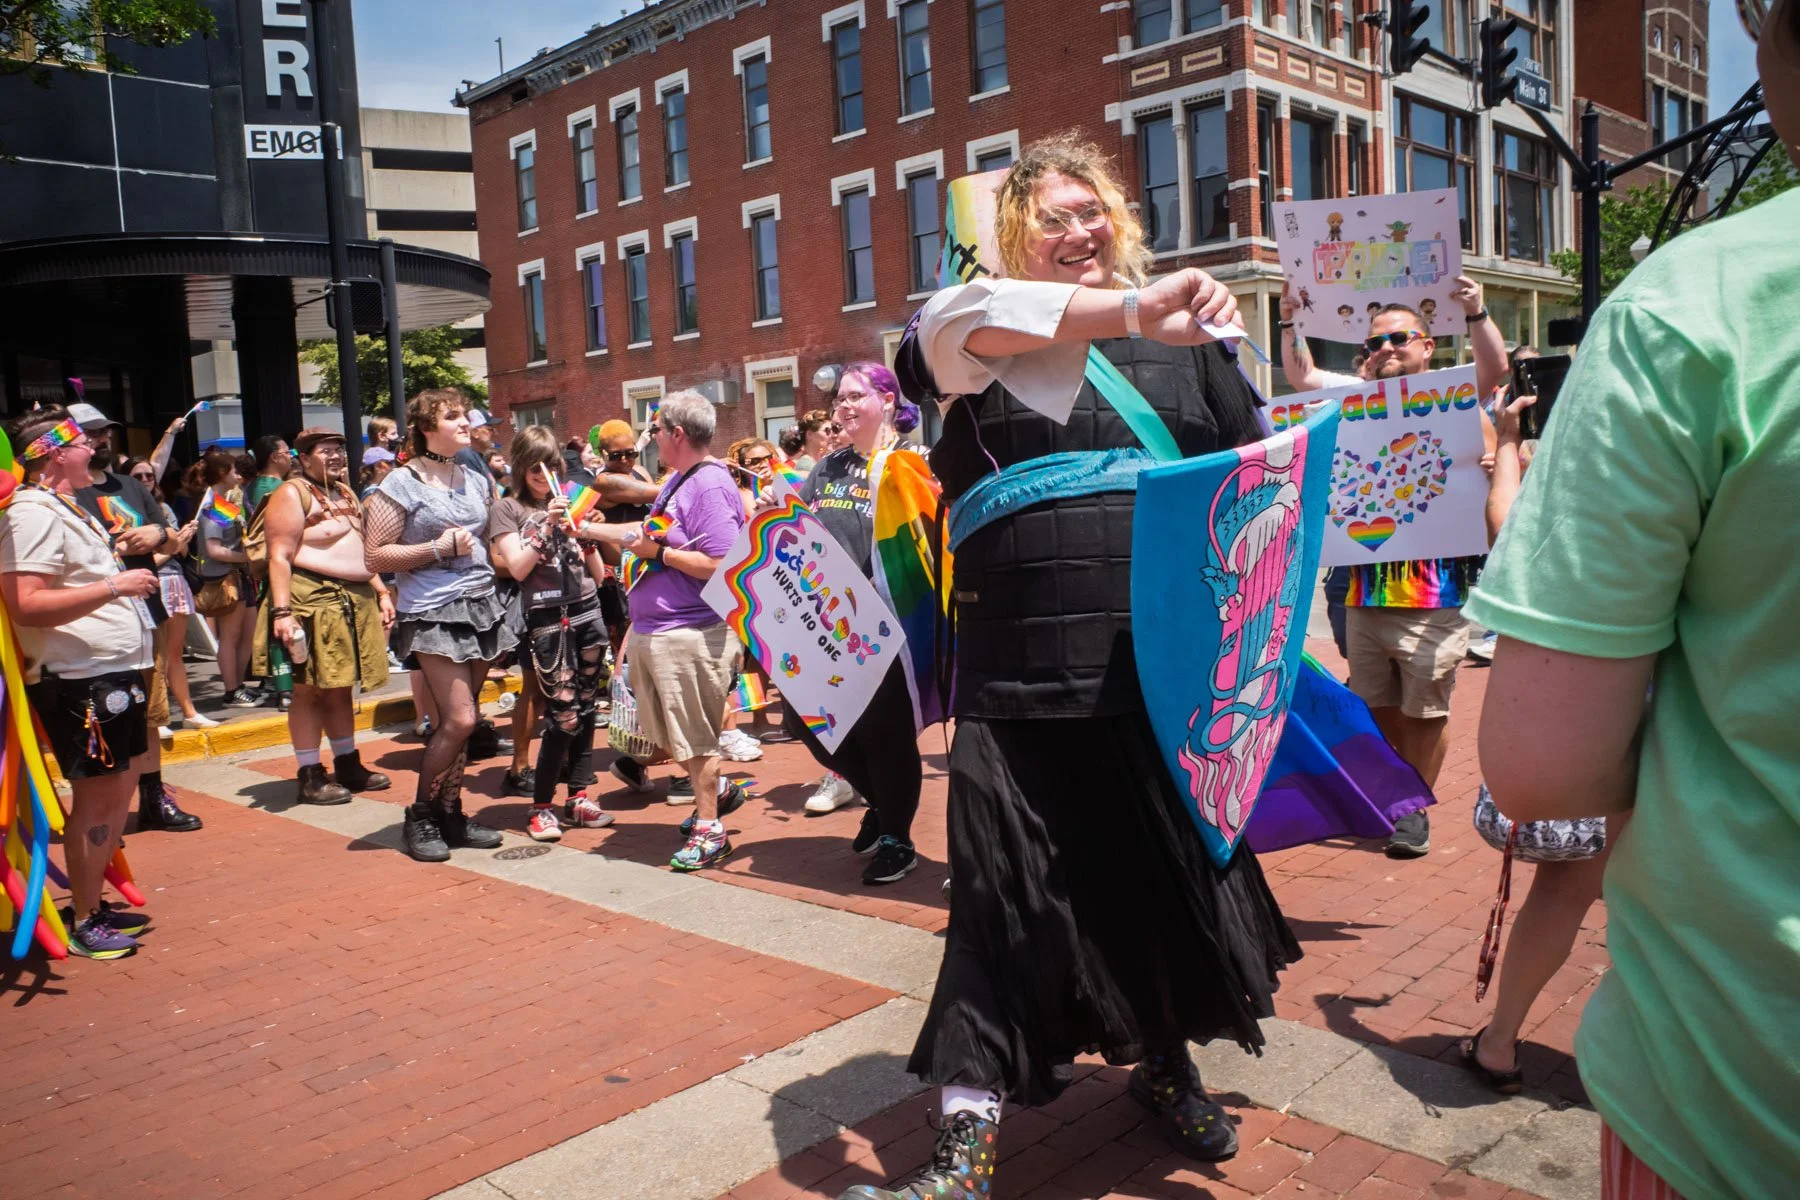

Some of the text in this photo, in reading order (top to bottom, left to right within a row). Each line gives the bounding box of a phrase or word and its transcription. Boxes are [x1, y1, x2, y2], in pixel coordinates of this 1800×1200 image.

[1519, 78, 1547, 105] Main St
[1271, 377, 1477, 432] spad love
[823, 482, 848, 498] big
[772, 565, 842, 663] HURTS NO ONE
